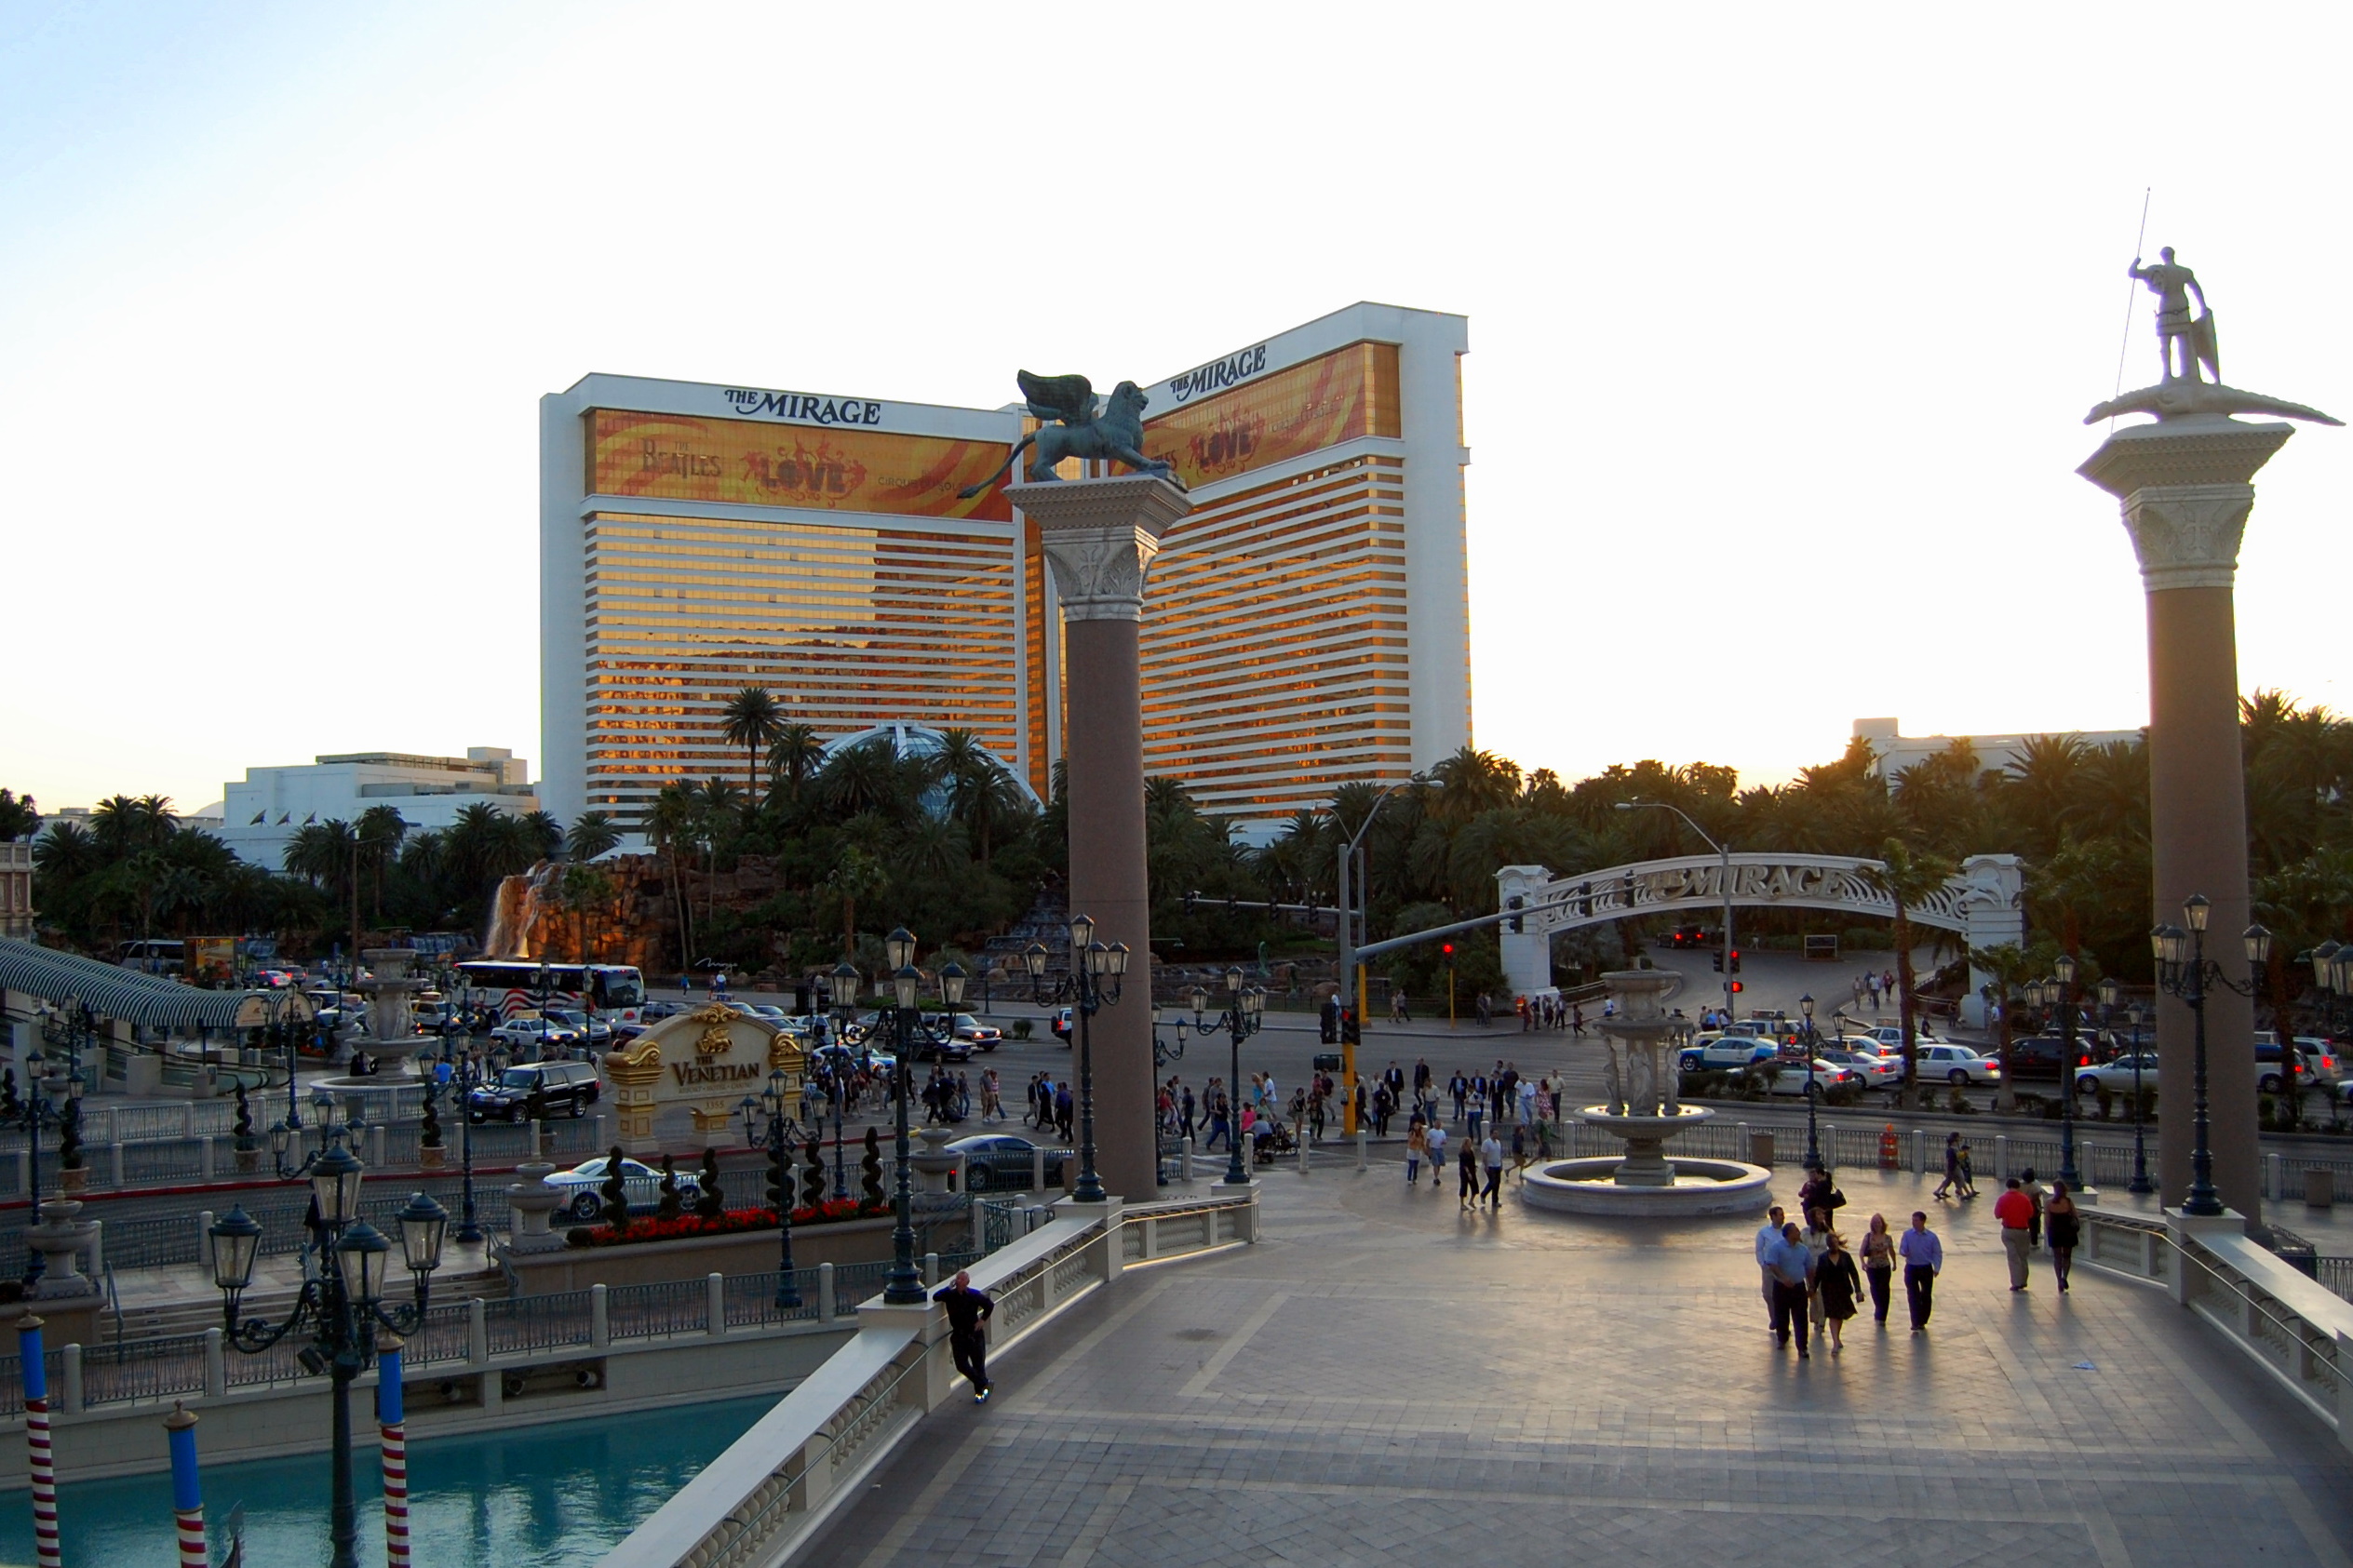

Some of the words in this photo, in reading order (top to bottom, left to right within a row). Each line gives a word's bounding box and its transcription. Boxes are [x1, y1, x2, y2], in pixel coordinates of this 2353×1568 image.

[1170, 375, 1190, 394] THE
[1176, 344, 1266, 402] MIRAGE
[724, 389, 758, 406] THE
[736, 392, 881, 425] MIRAGE
[642, 438, 721, 479] BEATLES
[1657, 864, 1845, 901] MIRAGE
[694, 1055, 716, 1065] THE
[671, 1063, 760, 1086] VENETIAN
